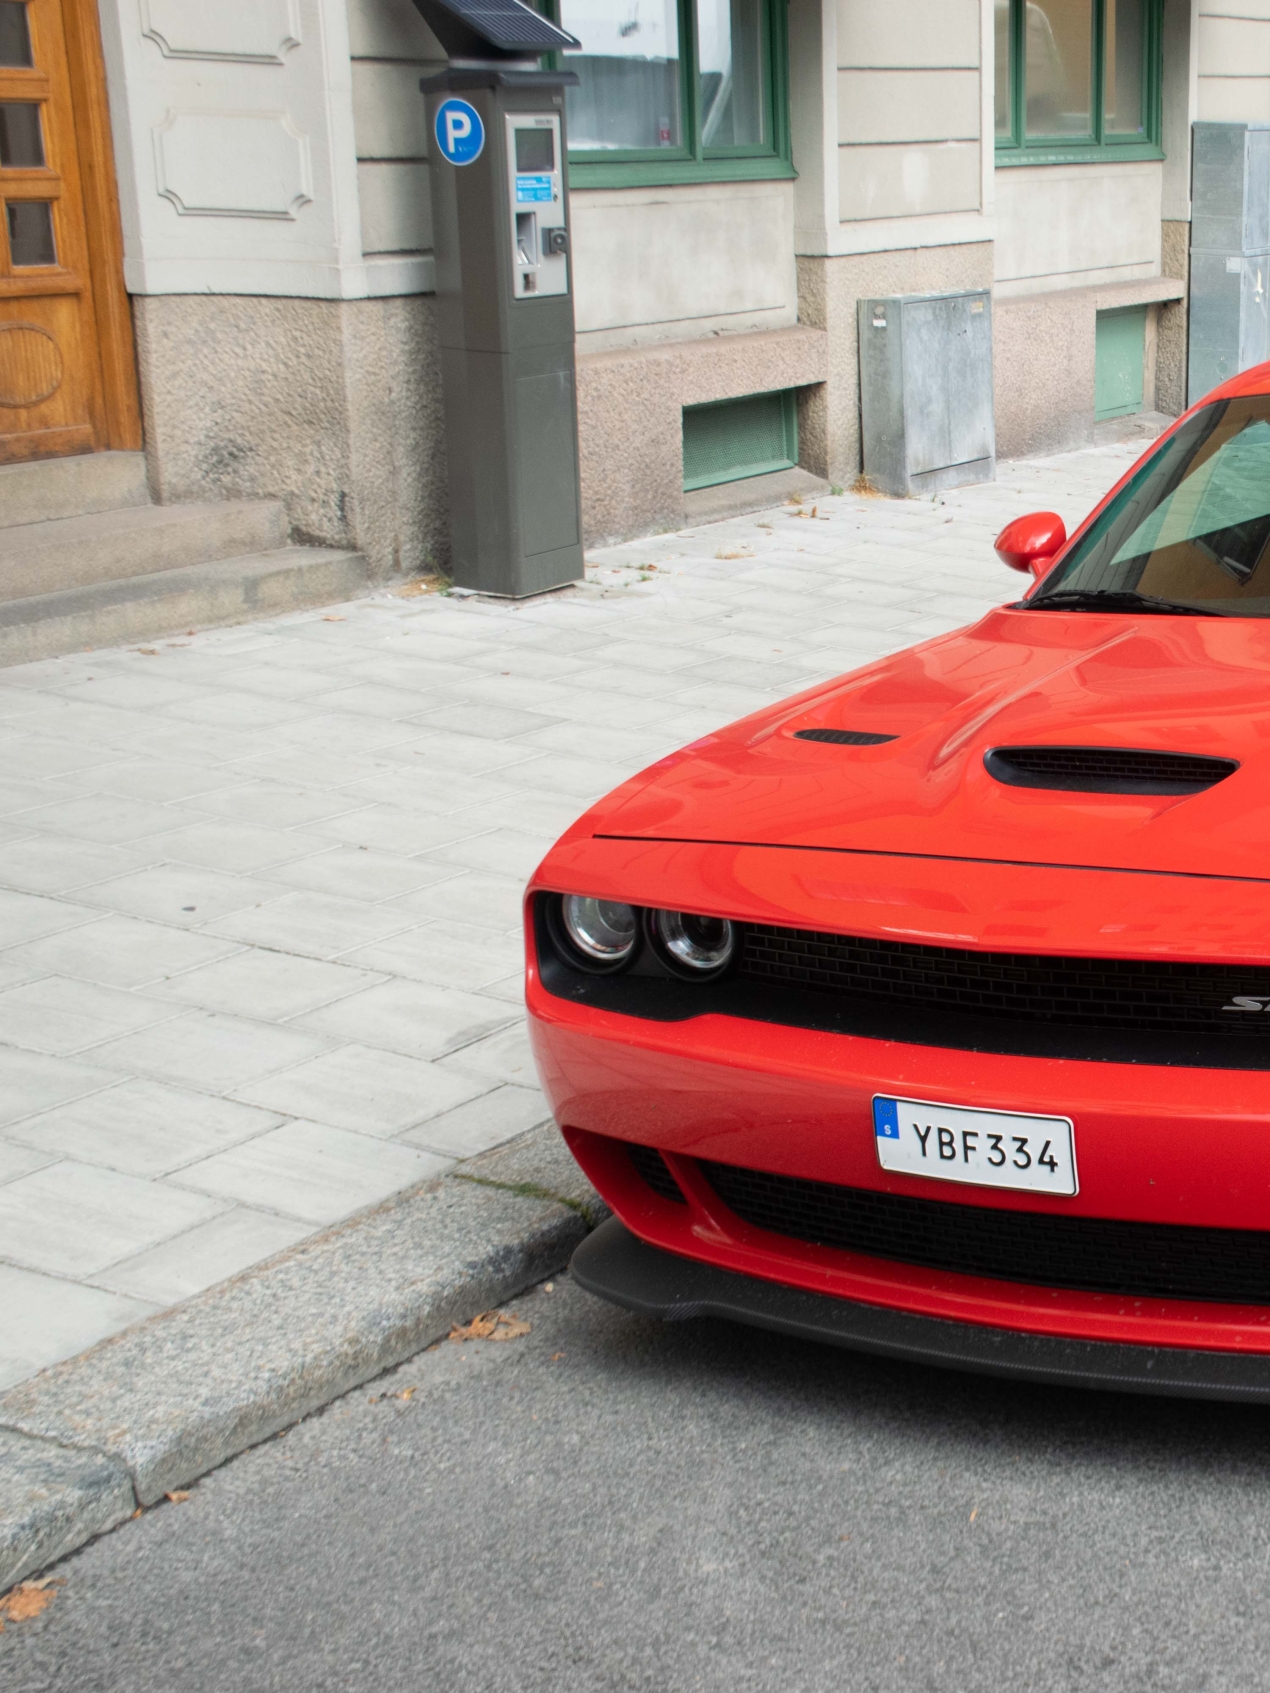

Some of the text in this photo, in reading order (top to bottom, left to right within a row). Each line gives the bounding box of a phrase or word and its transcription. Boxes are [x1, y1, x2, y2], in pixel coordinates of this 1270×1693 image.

[445, 110, 472, 154] P
[884, 1124, 892, 1135] S
[913, 1123, 1058, 1173] YBF334
